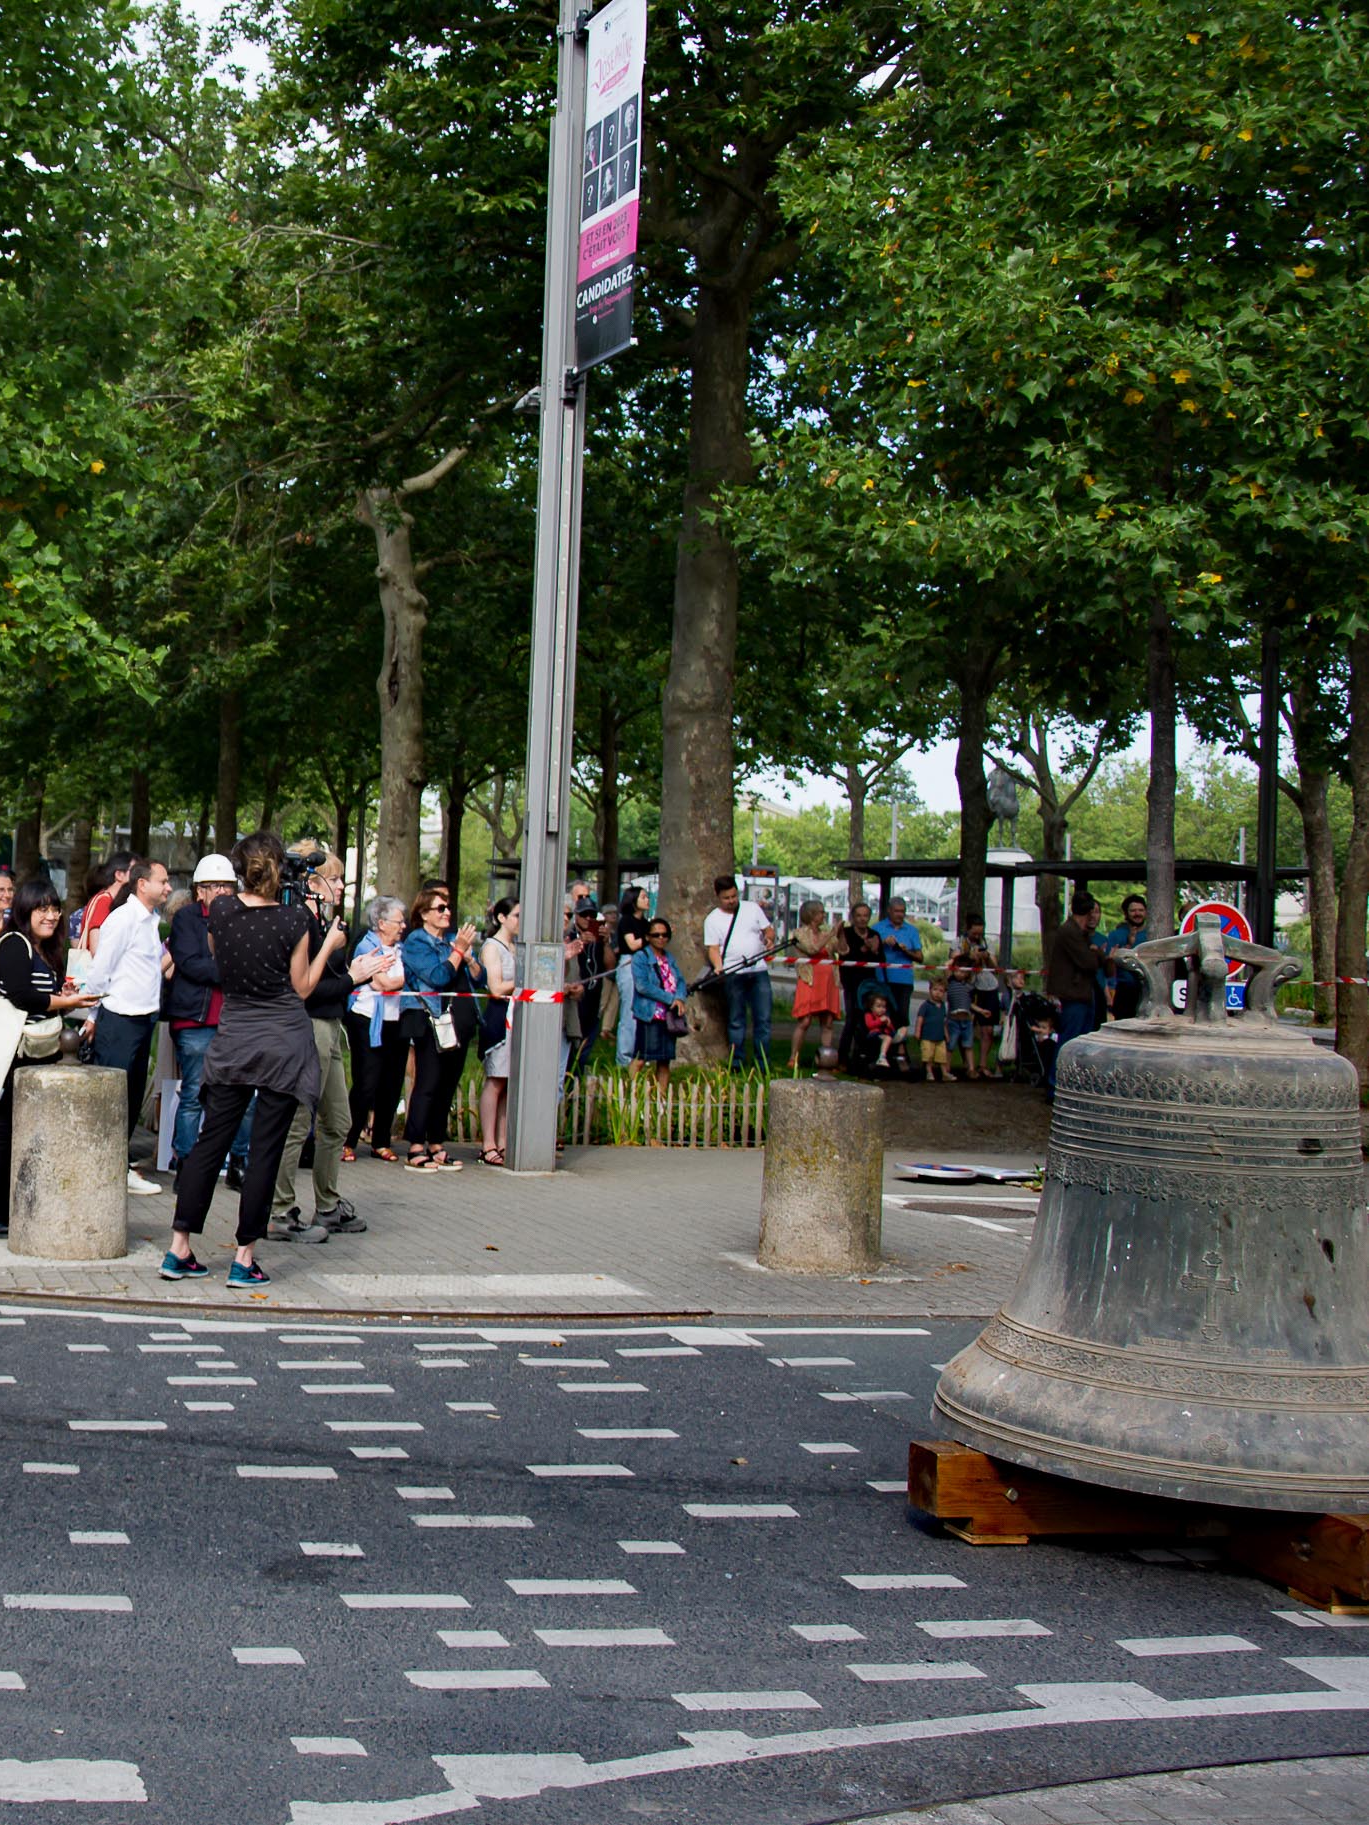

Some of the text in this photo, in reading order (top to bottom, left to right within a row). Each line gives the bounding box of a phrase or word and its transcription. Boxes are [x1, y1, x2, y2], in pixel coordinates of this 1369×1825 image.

[586, 232, 595, 245] ET
[603, 222, 613, 236] EN
[607, 229, 626, 247] VOUS
[577, 264, 634, 309] CANDIDATEZ
